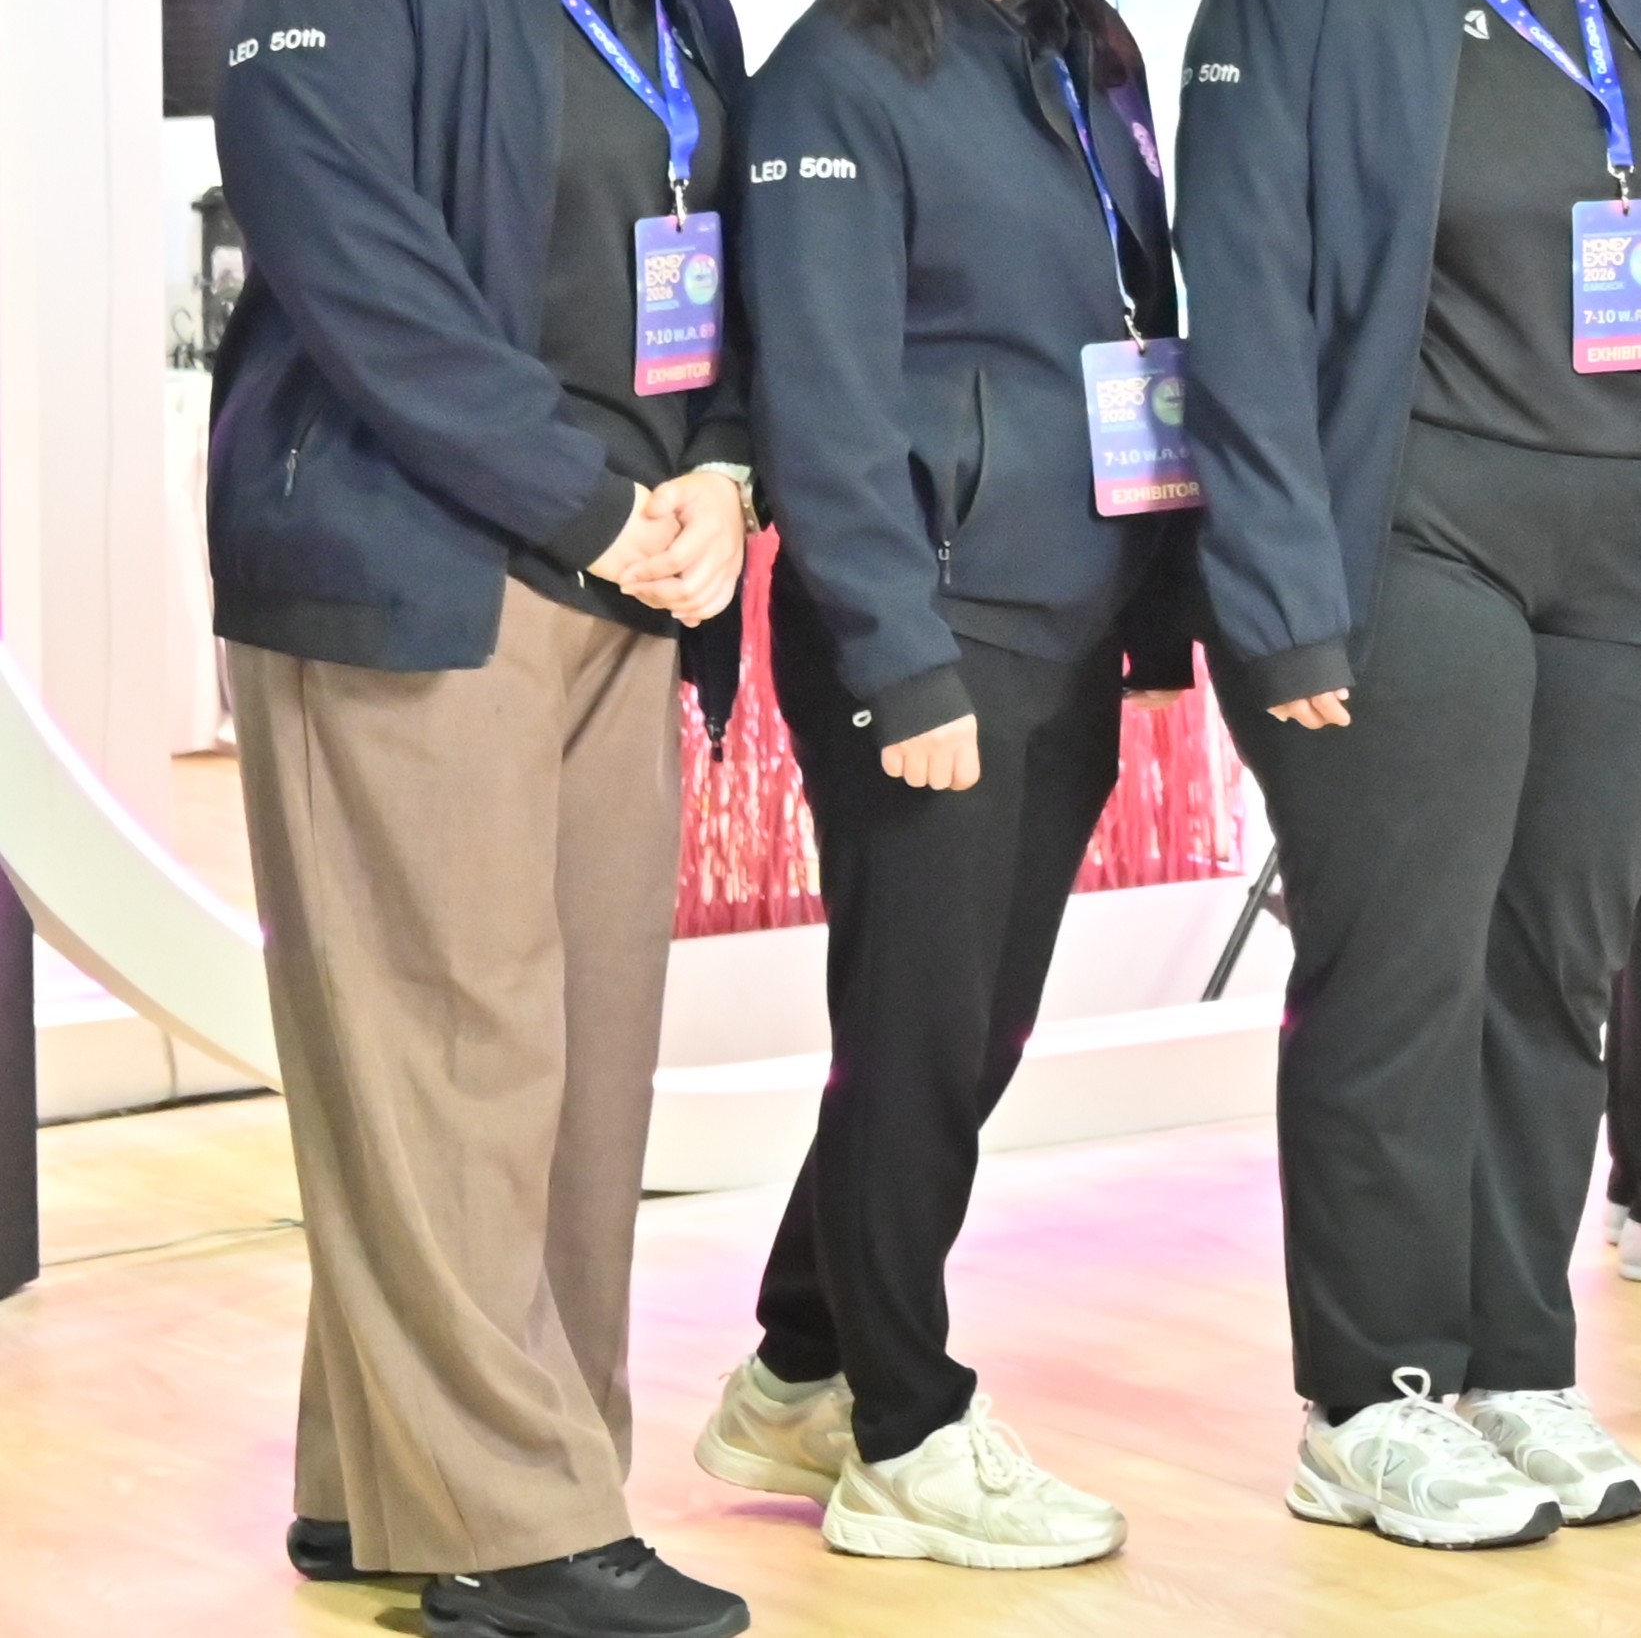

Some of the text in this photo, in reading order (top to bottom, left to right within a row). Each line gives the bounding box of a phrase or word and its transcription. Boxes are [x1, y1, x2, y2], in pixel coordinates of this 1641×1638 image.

[228, 26, 326, 67] LED 50th
[1198, 62, 1241, 84] 50th
[750, 156, 857, 184] LED 50th
[1581, 236, 1632, 253] MONEY
[1581, 251, 1625, 268] EXPO
[1583, 267, 1616, 282] 2026
